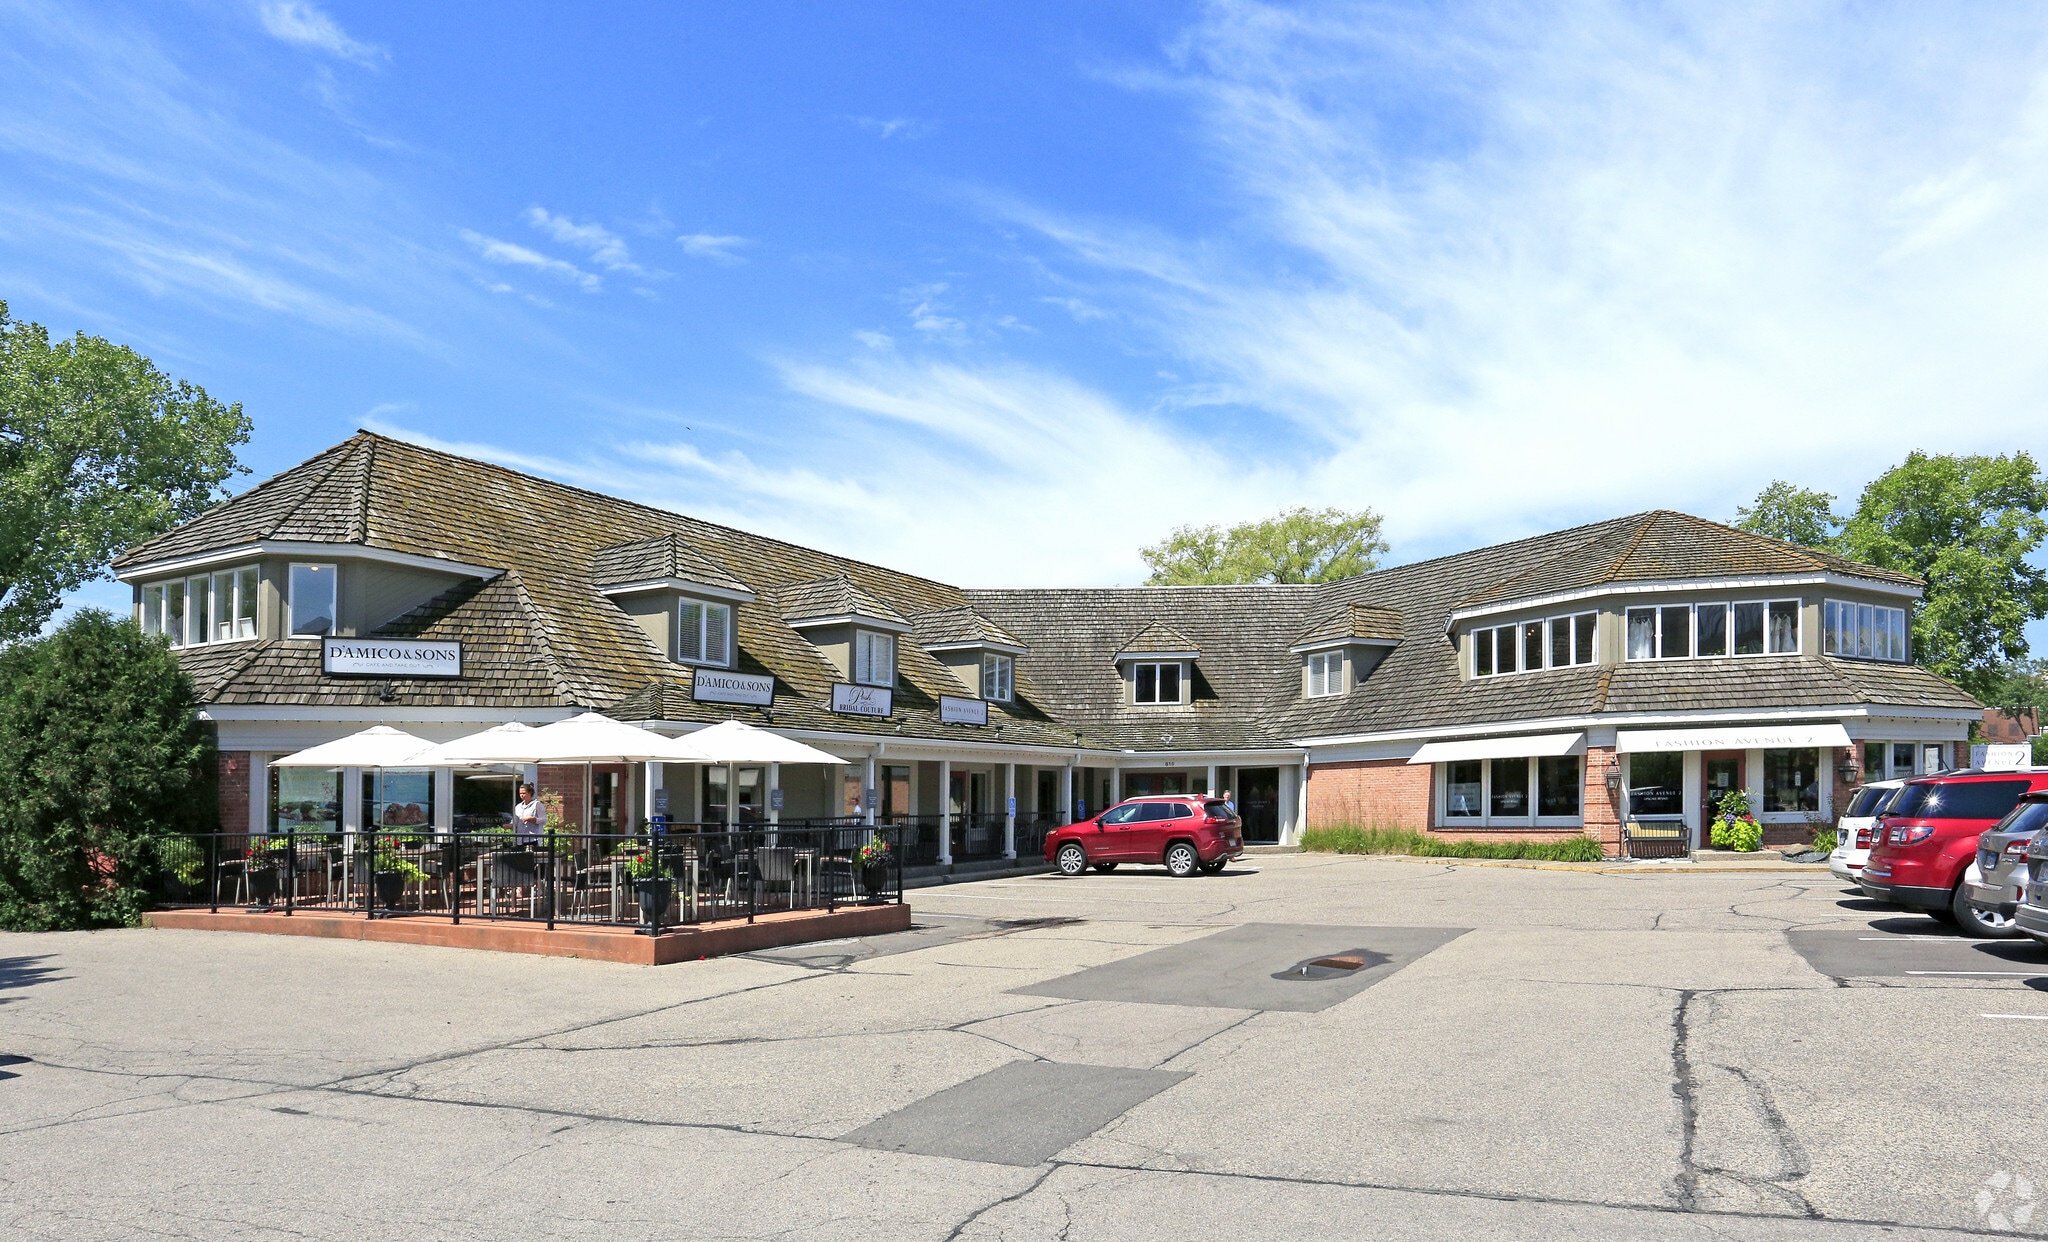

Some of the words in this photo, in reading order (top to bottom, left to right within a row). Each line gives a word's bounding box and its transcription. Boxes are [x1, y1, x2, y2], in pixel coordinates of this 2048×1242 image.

[414, 649, 456, 661] SONS
[746, 681, 771, 692] SONS
[839, 703, 858, 711] BRIDAL
[860, 705, 884, 714] COUTURE
[1655, 739, 1725, 747] FASHION
[1734, 736, 1797, 746] AVENUE
[2015, 750, 2026, 766] 2
